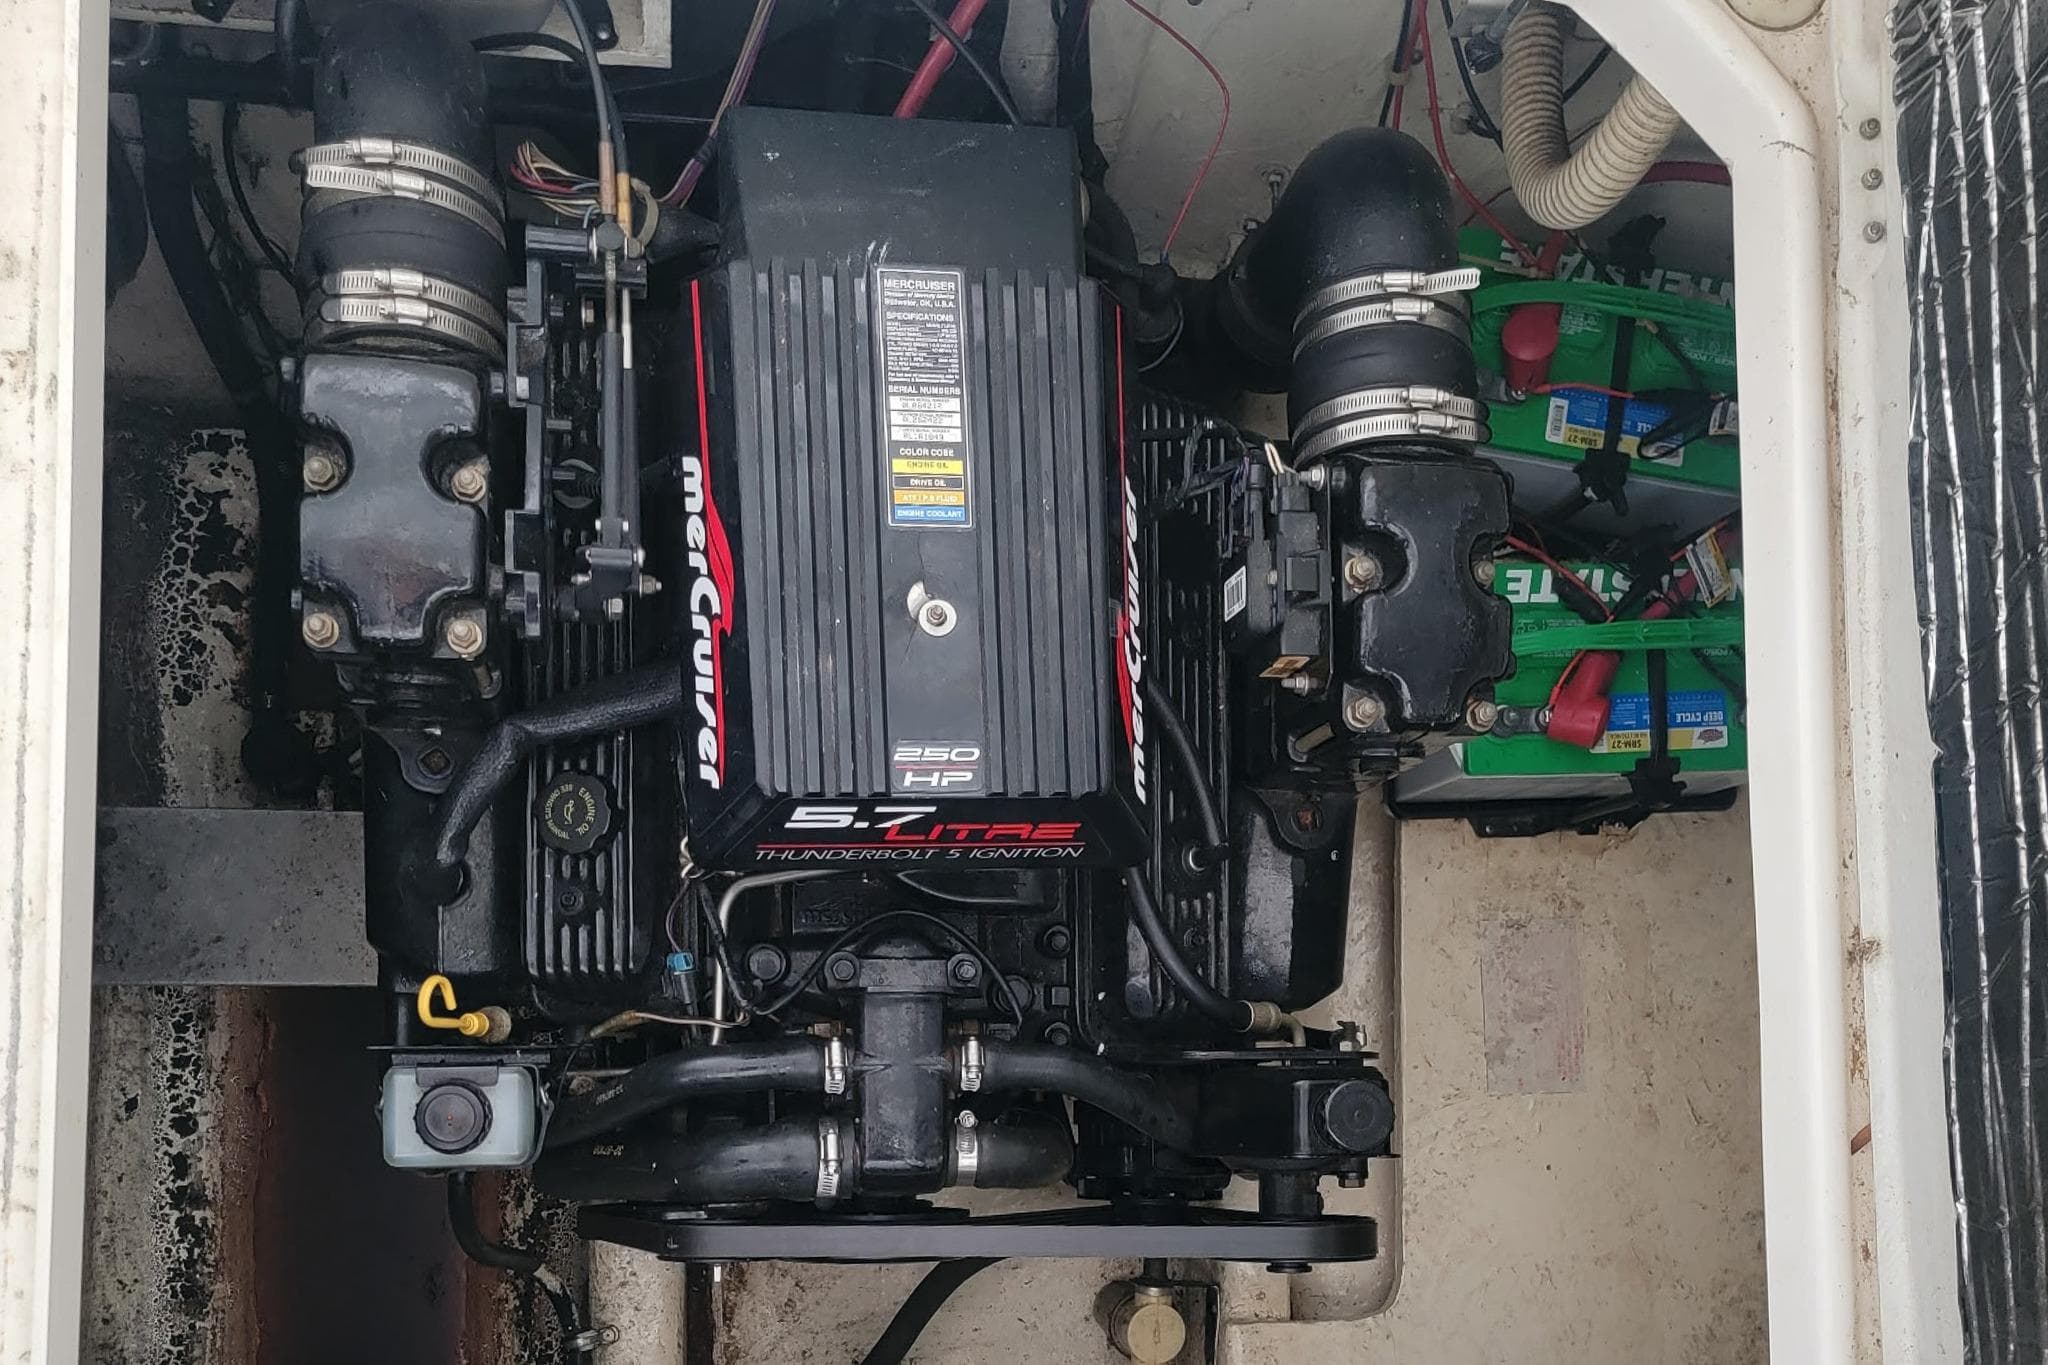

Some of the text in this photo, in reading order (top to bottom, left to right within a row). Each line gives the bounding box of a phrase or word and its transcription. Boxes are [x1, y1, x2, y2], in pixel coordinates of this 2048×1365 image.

[884, 279, 955, 291] MERCRUISER
[886, 311, 955, 321] SPECIFICATIONS
[888, 384, 961, 395] SERIAL NUMBERS
[899, 447, 929, 457] COLOR
[910, 479, 947, 487] DRIVE OIL
[897, 509, 962, 518] ENGINE COOLANT
[1676, 711, 1723, 722] DEEP CYCLE
[1612, 739, 1642, 749] SRM-27
[894, 748, 980, 762] 250
[903, 771, 973, 787] HP
[576, 787, 596, 836] ENGINE OIL
[784, 806, 937, 829] 5.7
[884, 823, 1082, 840] LITRE
[756, 847, 1085, 861] THUNDERBOLT 5 IGNITION
